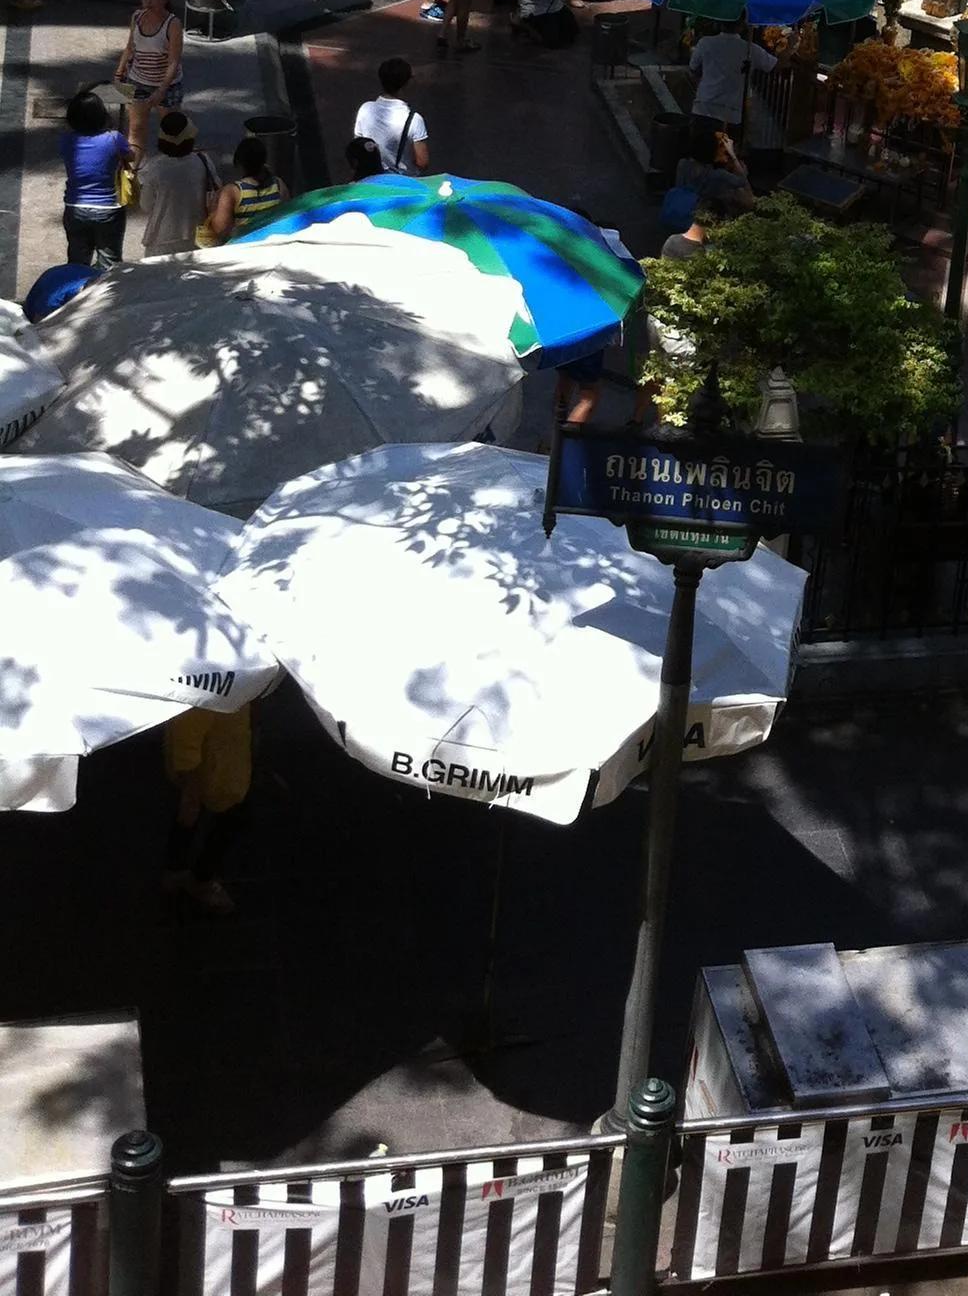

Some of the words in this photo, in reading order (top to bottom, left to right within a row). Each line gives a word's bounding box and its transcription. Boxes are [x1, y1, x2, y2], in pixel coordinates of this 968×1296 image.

[606, 455, 795, 494] ถนนเพลินจิต
[610, 486, 674, 505] Thanon
[682, 492, 742, 512] Phloen
[750, 499, 785, 516] Chit
[638, 723, 706, 762] VA
[391, 751, 534, 796] B.GRIMM
[861, 1133, 903, 1148] VISA
[382, 1195, 429, 1213] VISA
